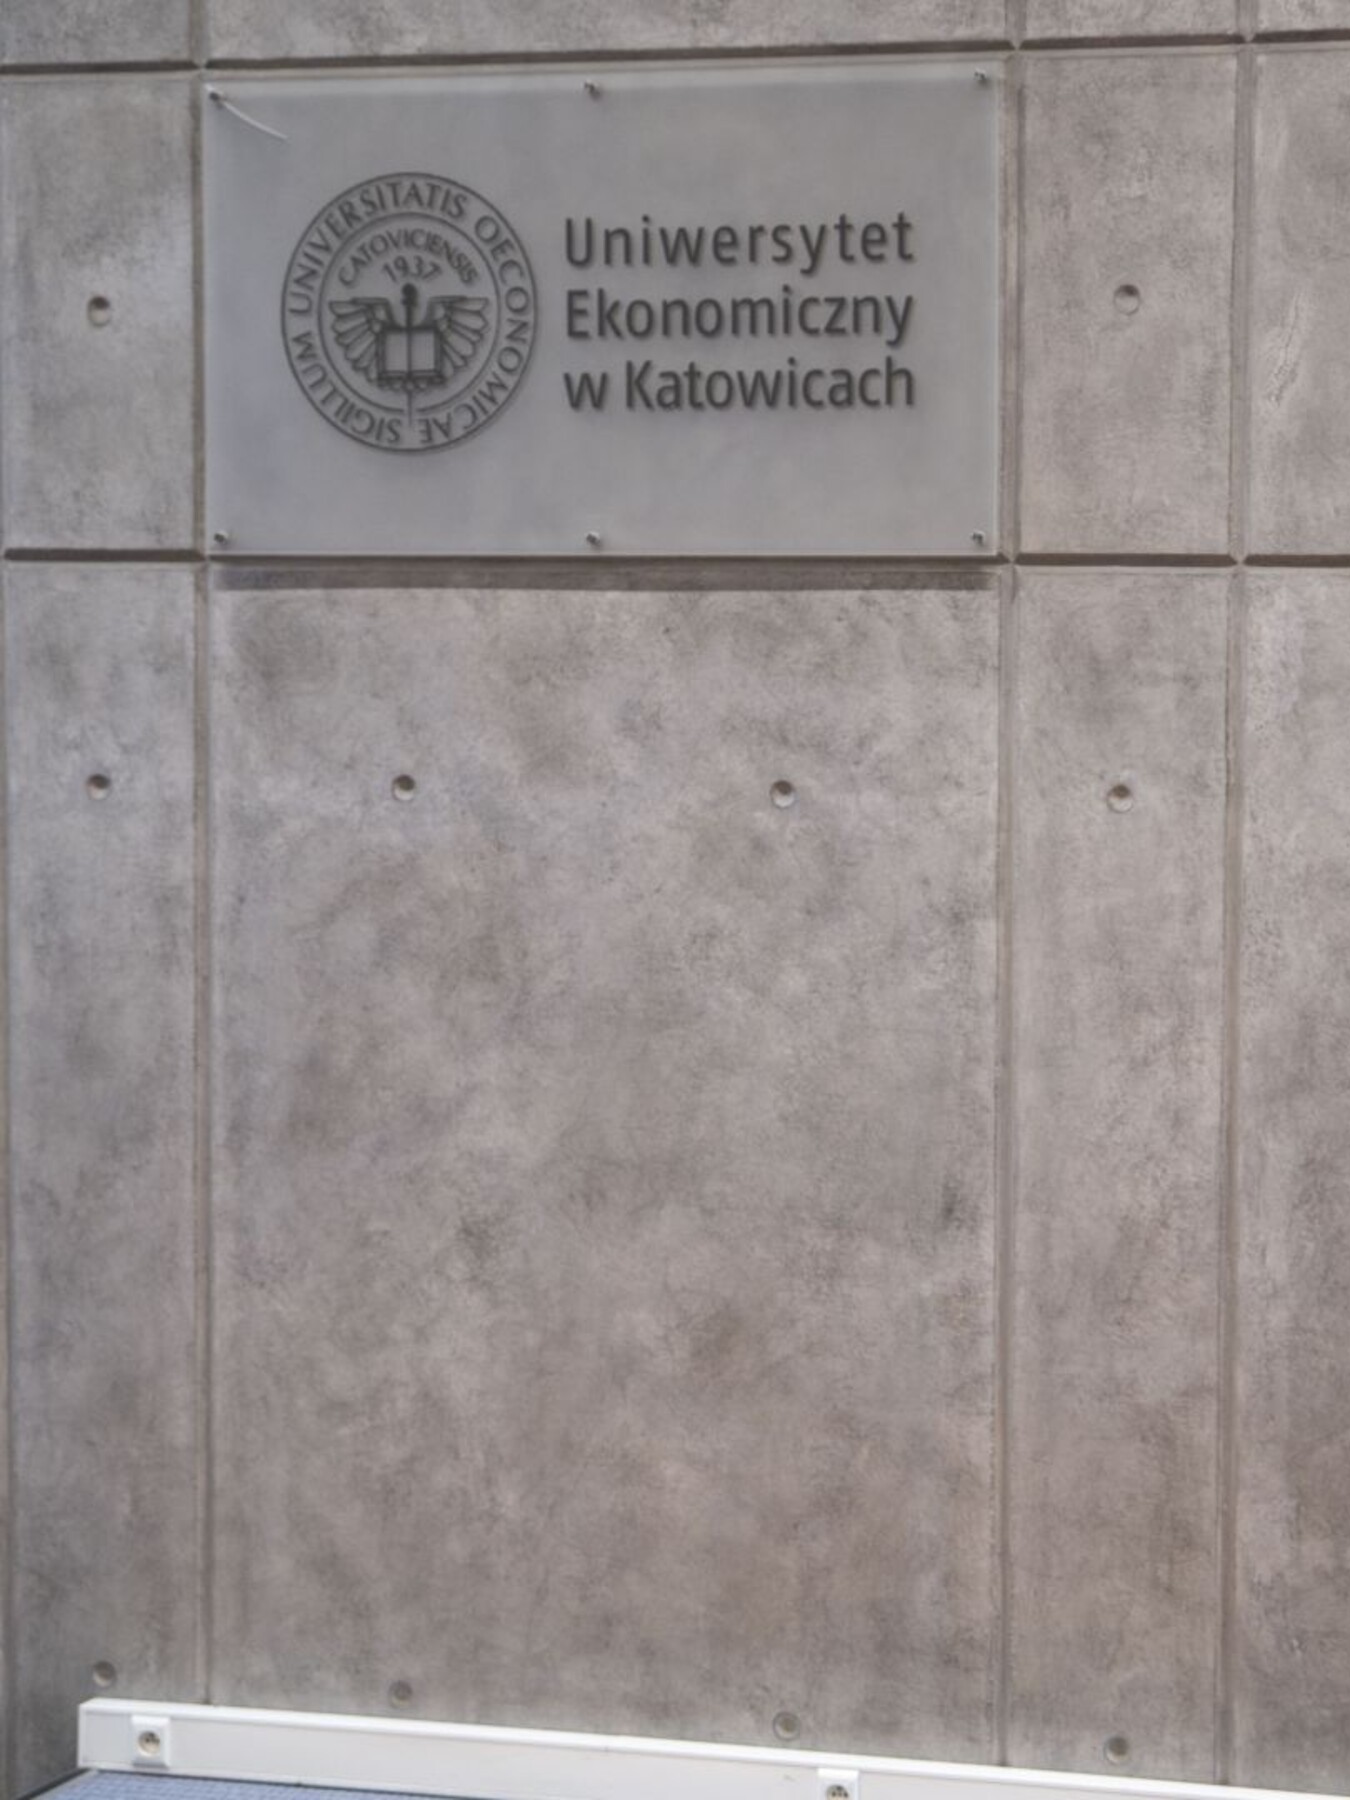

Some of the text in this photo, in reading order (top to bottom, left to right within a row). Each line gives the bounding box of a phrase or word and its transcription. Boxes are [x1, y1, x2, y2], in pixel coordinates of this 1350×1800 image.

[337, 228, 478, 287] CATOVICIENSIS
[382, 255, 442, 283] 1937
[565, 212, 914, 275] Uniwersytet
[288, 181, 531, 443] SIGILLUM UNIVERSITATIS OECONOMICAE
[566, 284, 914, 347] Ekonomiczny
[564, 356, 915, 411] w Katowicach
